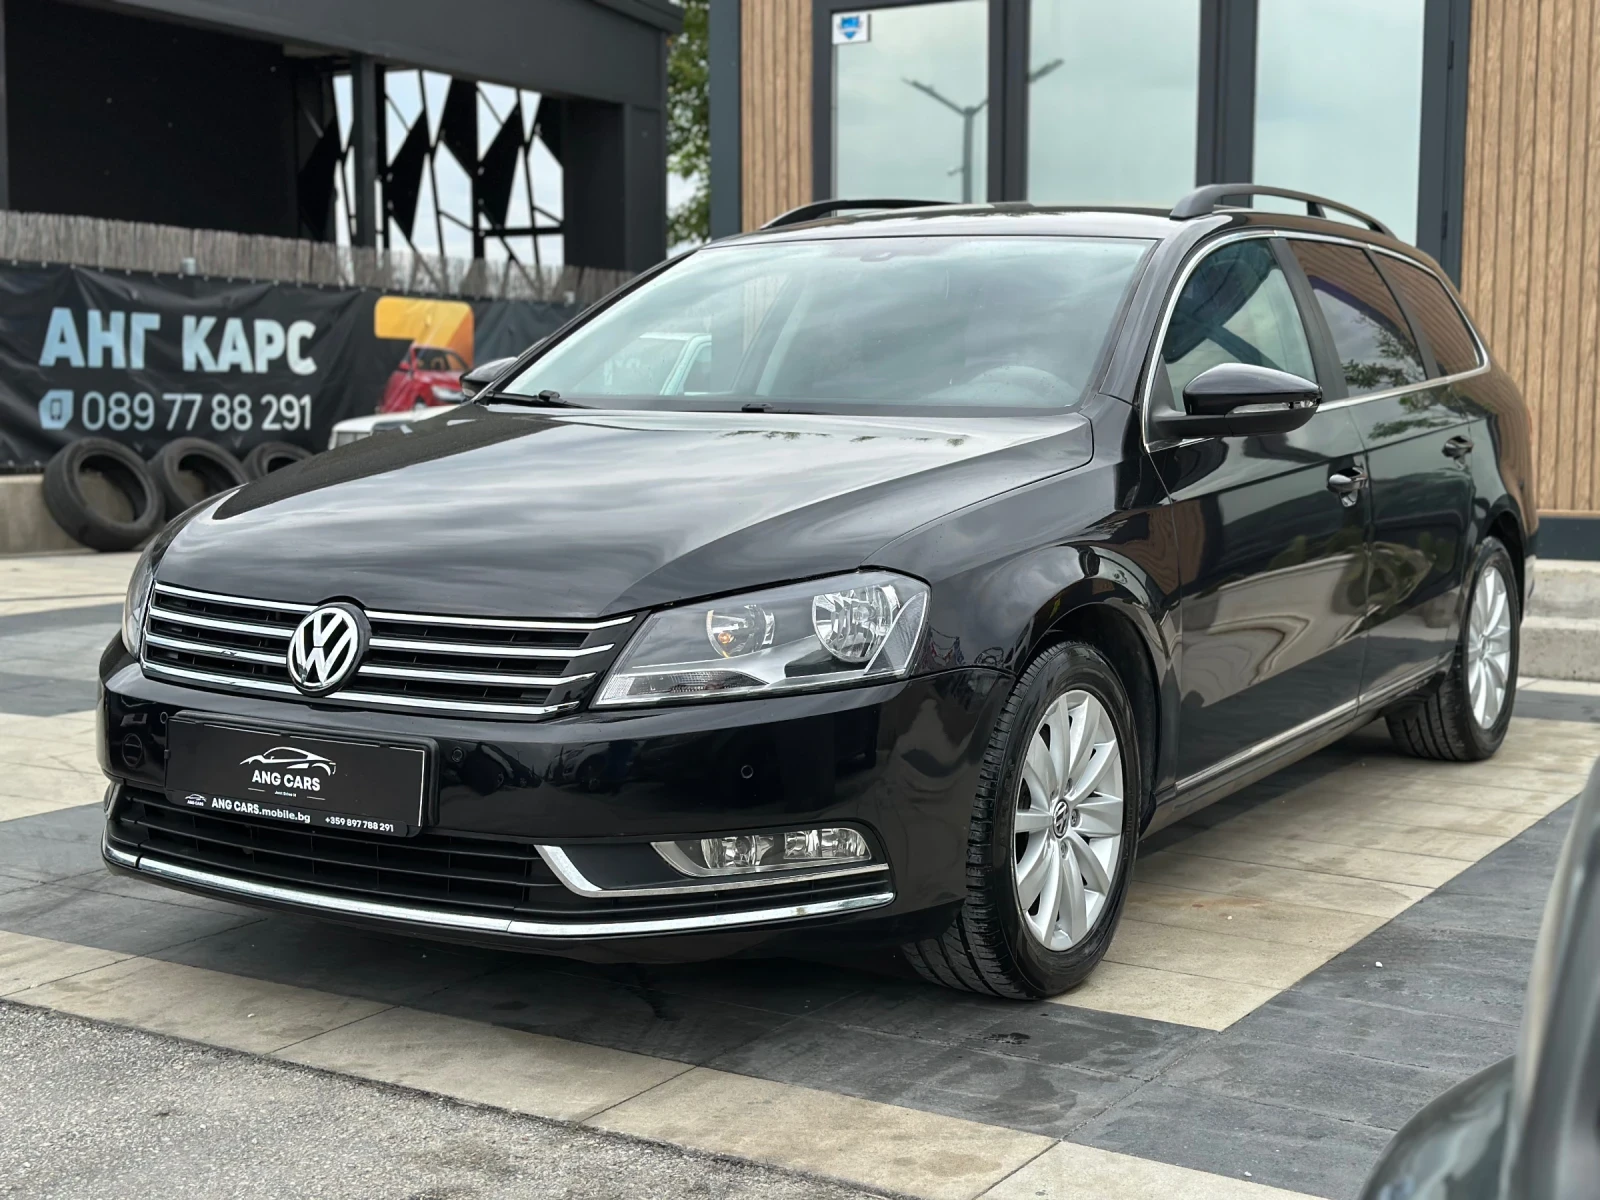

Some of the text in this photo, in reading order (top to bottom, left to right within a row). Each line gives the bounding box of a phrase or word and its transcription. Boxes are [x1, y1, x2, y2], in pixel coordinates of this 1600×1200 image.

[39, 307, 317, 375] АНГ КАРС
[81, 390, 312, 431] 089 77 88 291
[251, 769, 321, 791] ANG CARS
[211, 797, 311, 824] ANG CARS.mobile.bg
[325, 816, 394, 832] +359 897 788 291
